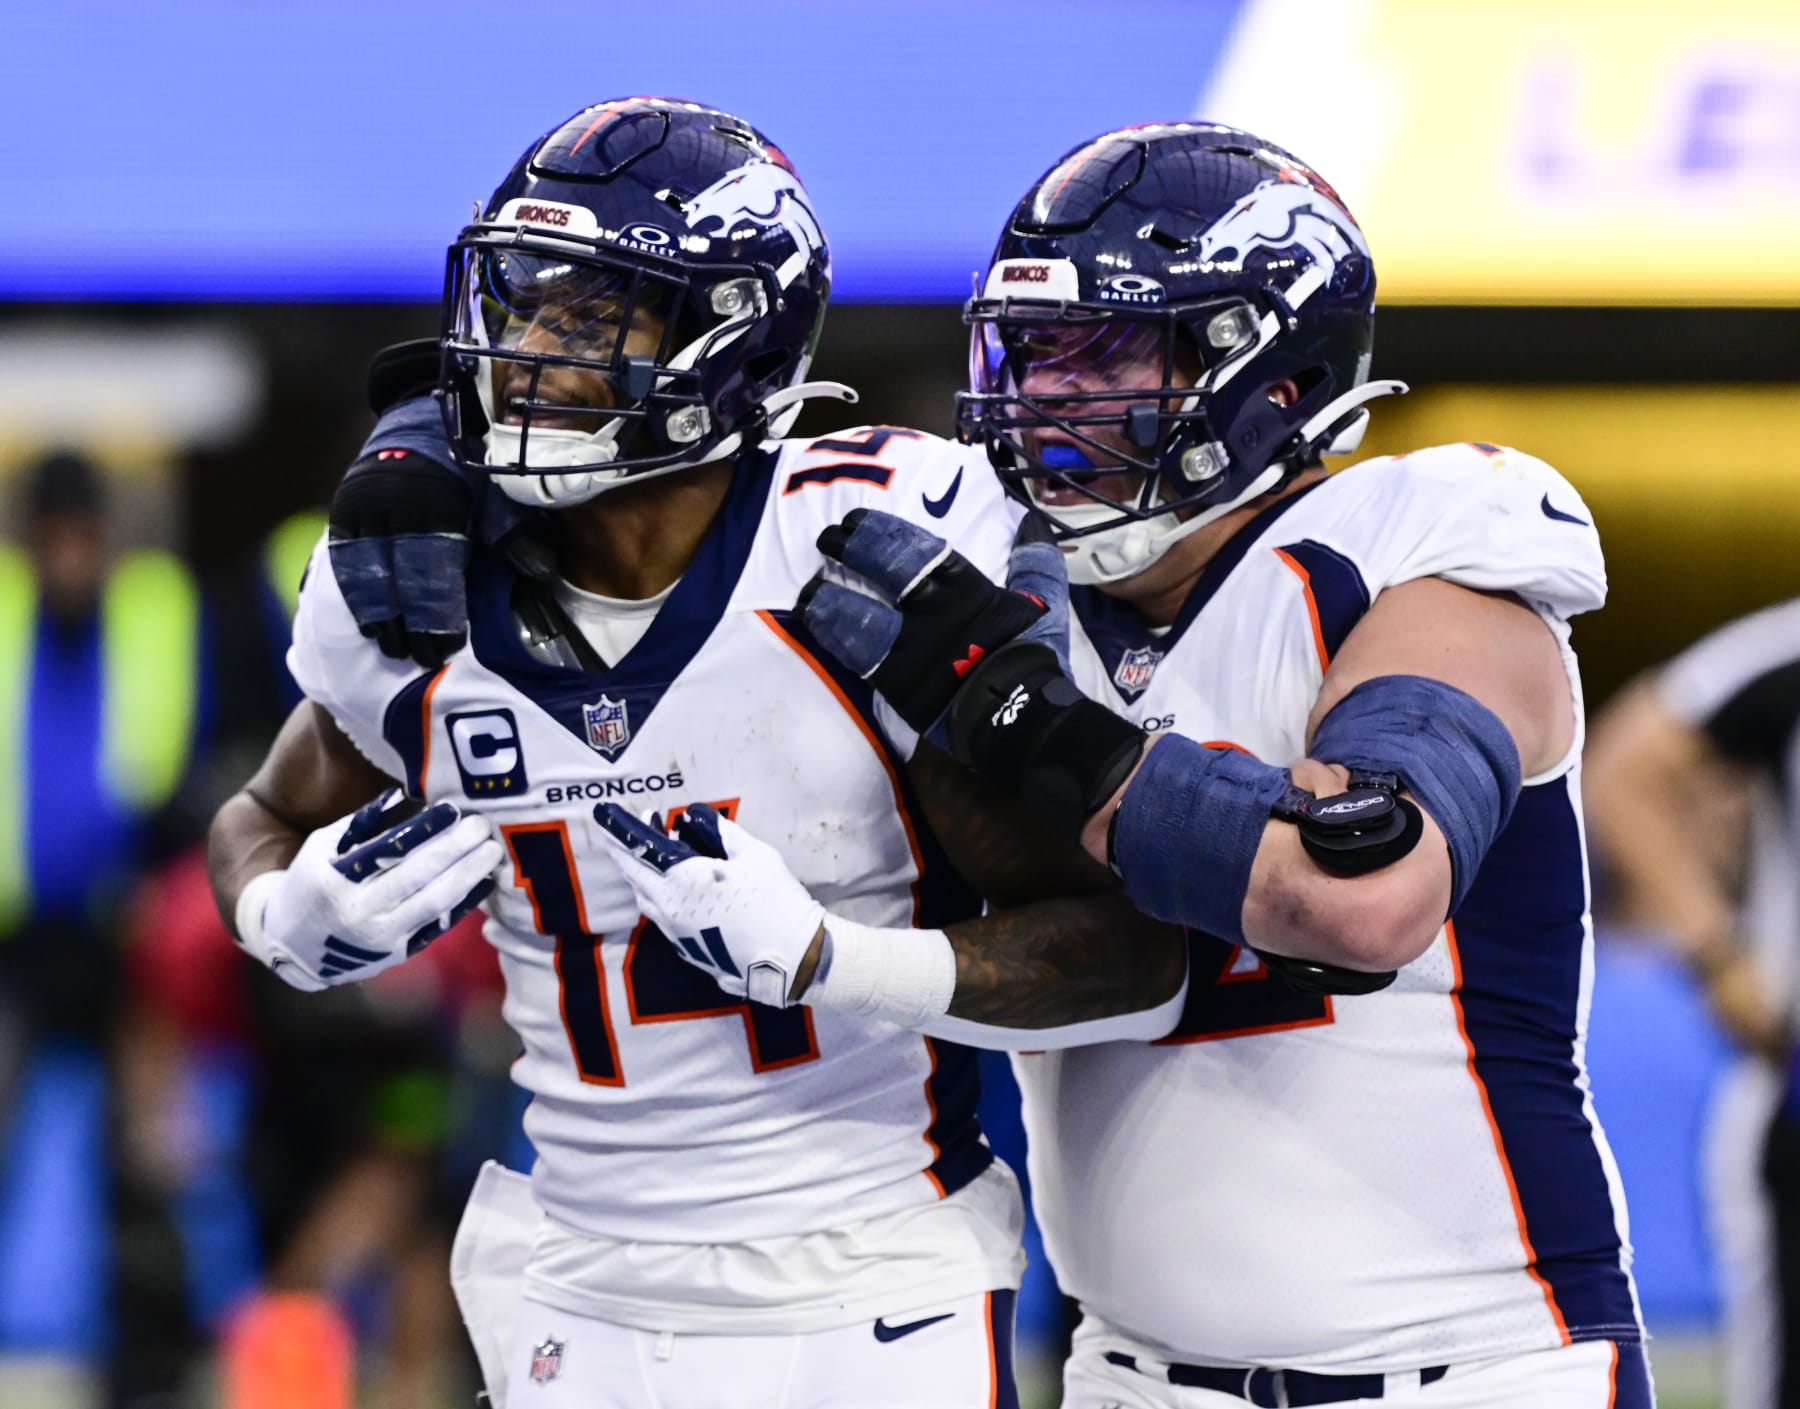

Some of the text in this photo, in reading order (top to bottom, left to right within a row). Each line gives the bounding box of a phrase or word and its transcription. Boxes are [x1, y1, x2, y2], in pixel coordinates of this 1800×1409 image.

[515, 204, 571, 226] BRONCOS
[618, 237, 677, 257] OAKLEY
[1002, 265, 1050, 282] BRONCOS
[1100, 290, 1160, 303] OAKLEY
[782, 424, 929, 496] 14
[592, 722, 623, 744] NFL
[451, 714, 518, 777] C
[546, 772, 684, 803] BRONCOS
